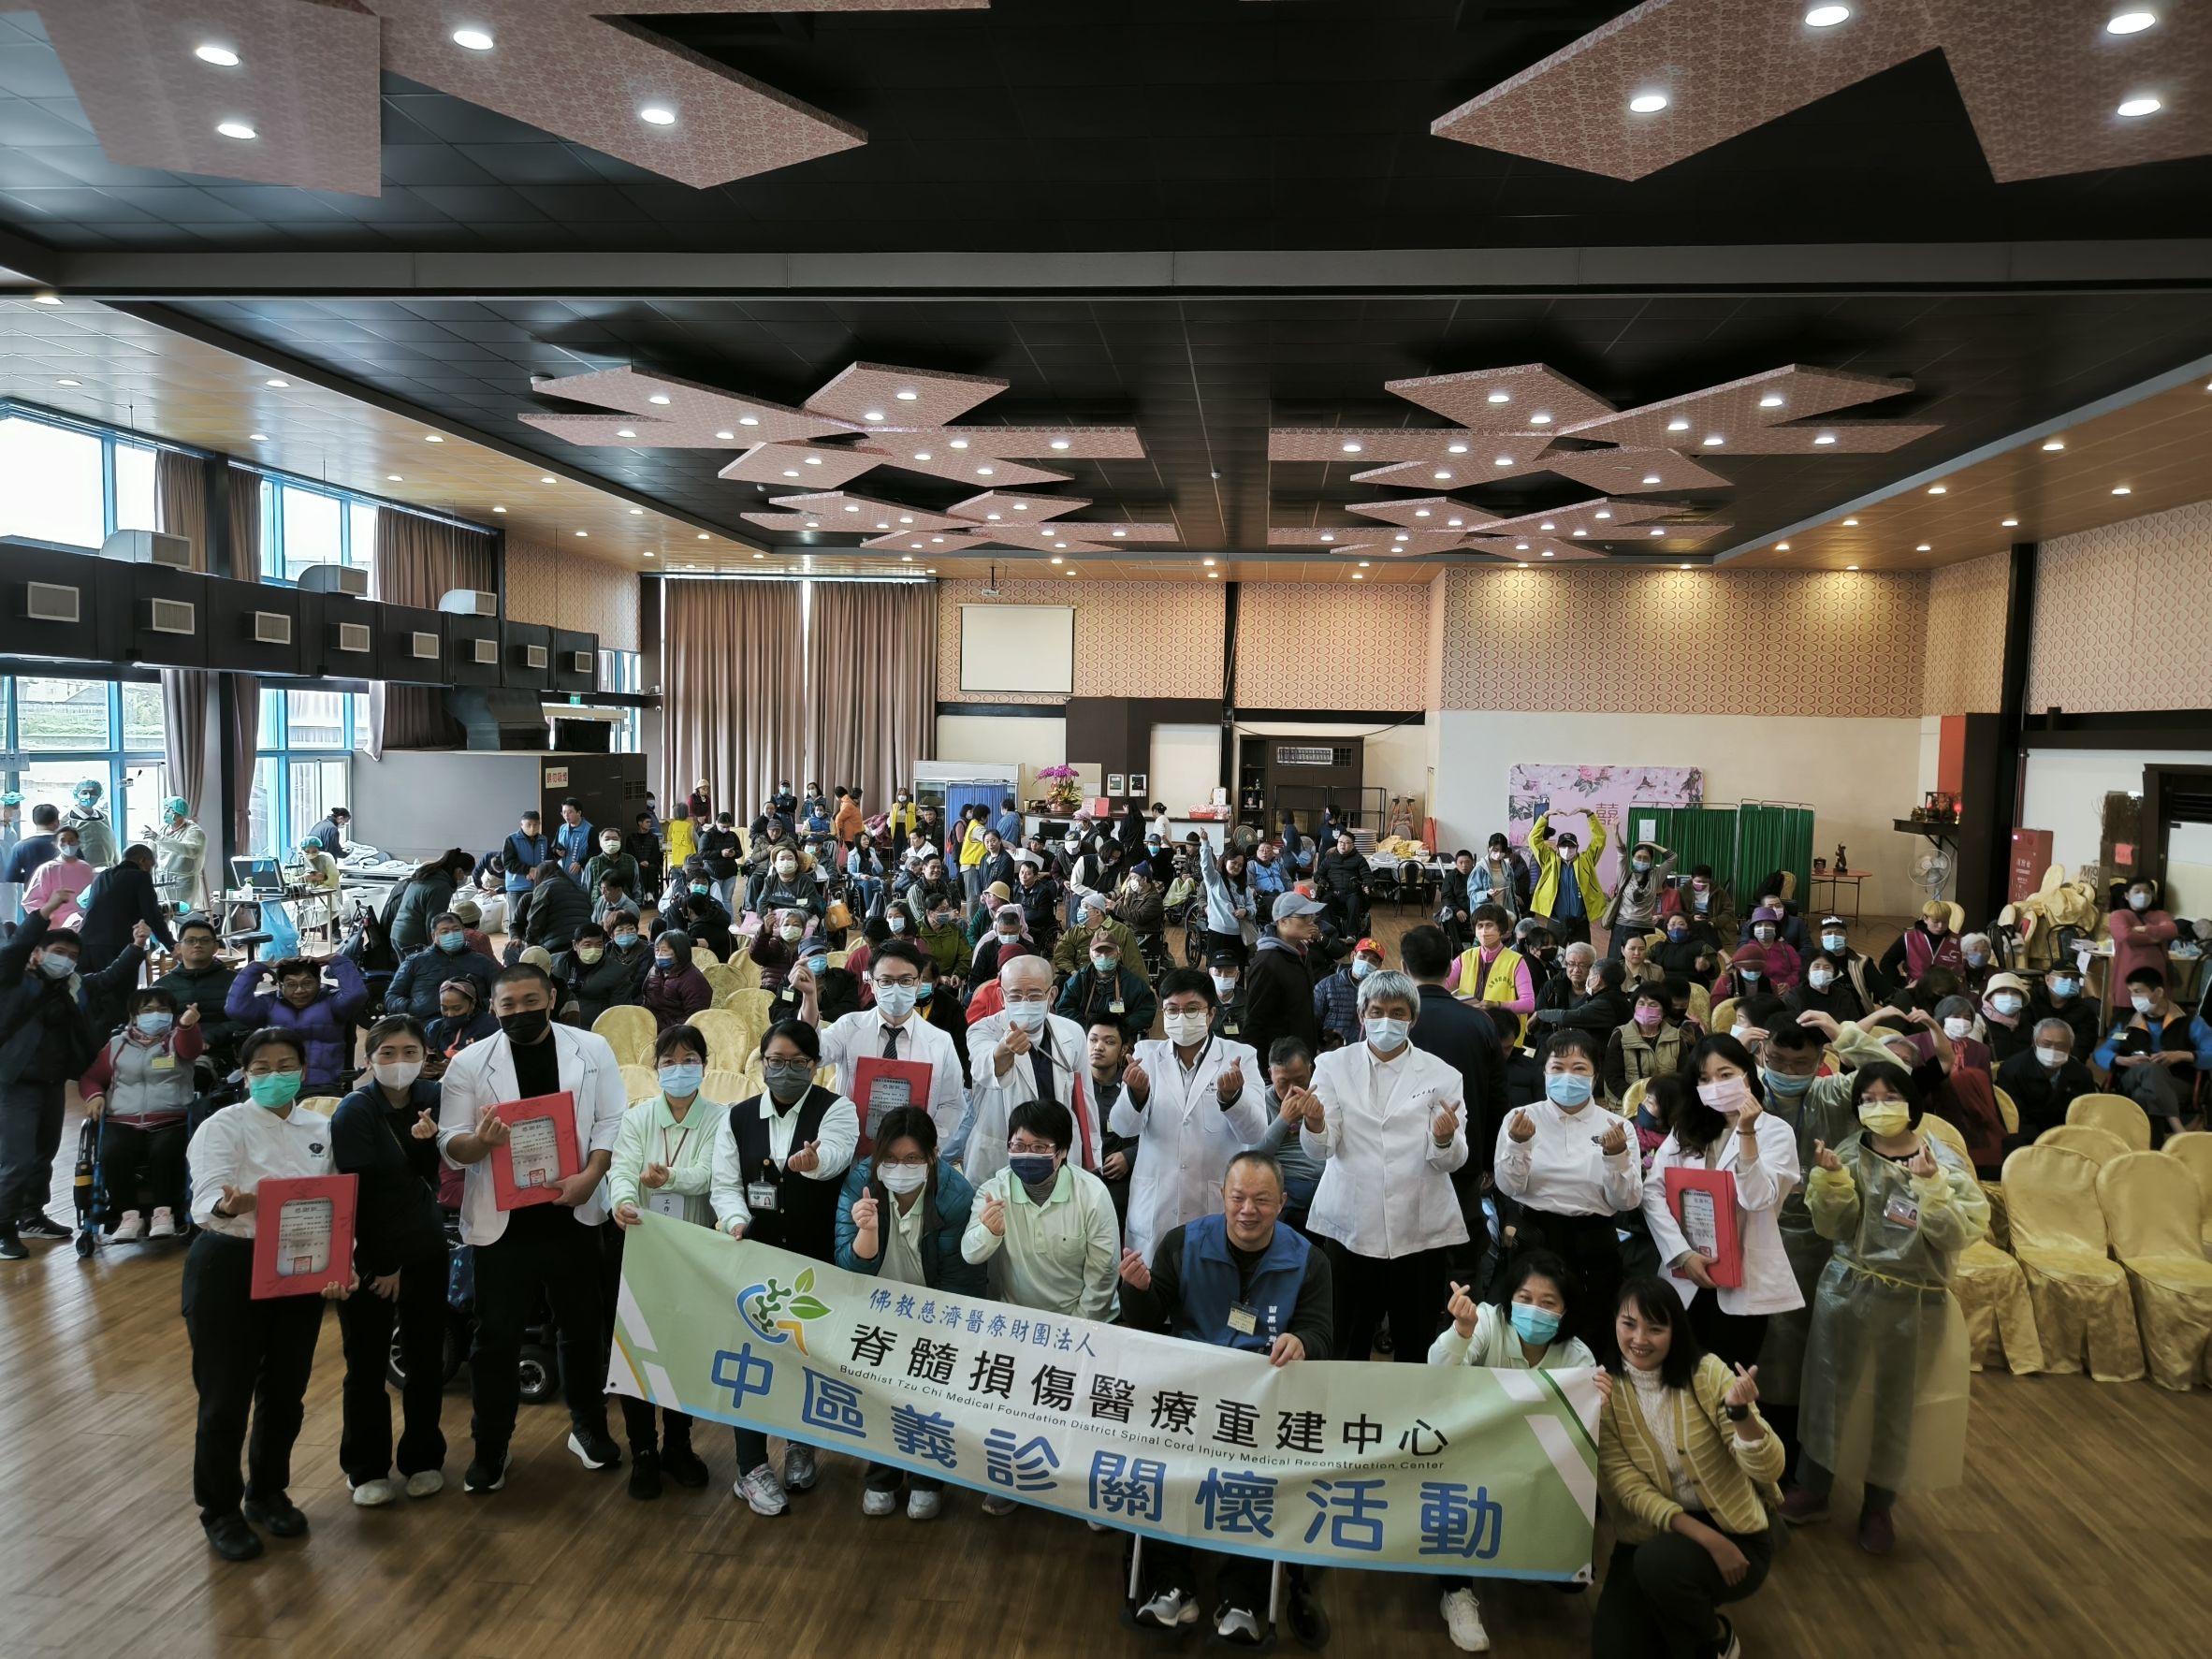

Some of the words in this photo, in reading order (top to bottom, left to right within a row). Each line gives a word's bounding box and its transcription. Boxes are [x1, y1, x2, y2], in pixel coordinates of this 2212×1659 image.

[869, 1288, 1096, 1358] 佛教慈濟醫療財團法人
[840, 1364, 894, 1386] Buddhist
[897, 1379, 918, 1391] Tzu
[922, 1385, 943, 1398] Chi
[946, 1392, 995, 1411] Medical
[997, 1404, 1068, 1427] Foundation
[1070, 1419, 1115, 1437] District
[1120, 1431, 1160, 1446] Spinal
[1164, 1438, 1194, 1452] Cord
[1199, 1445, 1235, 1462] Injury
[1240, 1453, 1289, 1466] Medical
[1295, 1459, 1395, 1470] Reconstruction
[1400, 1462, 1445, 1470] Center
[850, 1323, 1448, 1457] 脊髓損傷醫療重建中心
[711, 1343, 1503, 1560] 中區義診關懷活動
